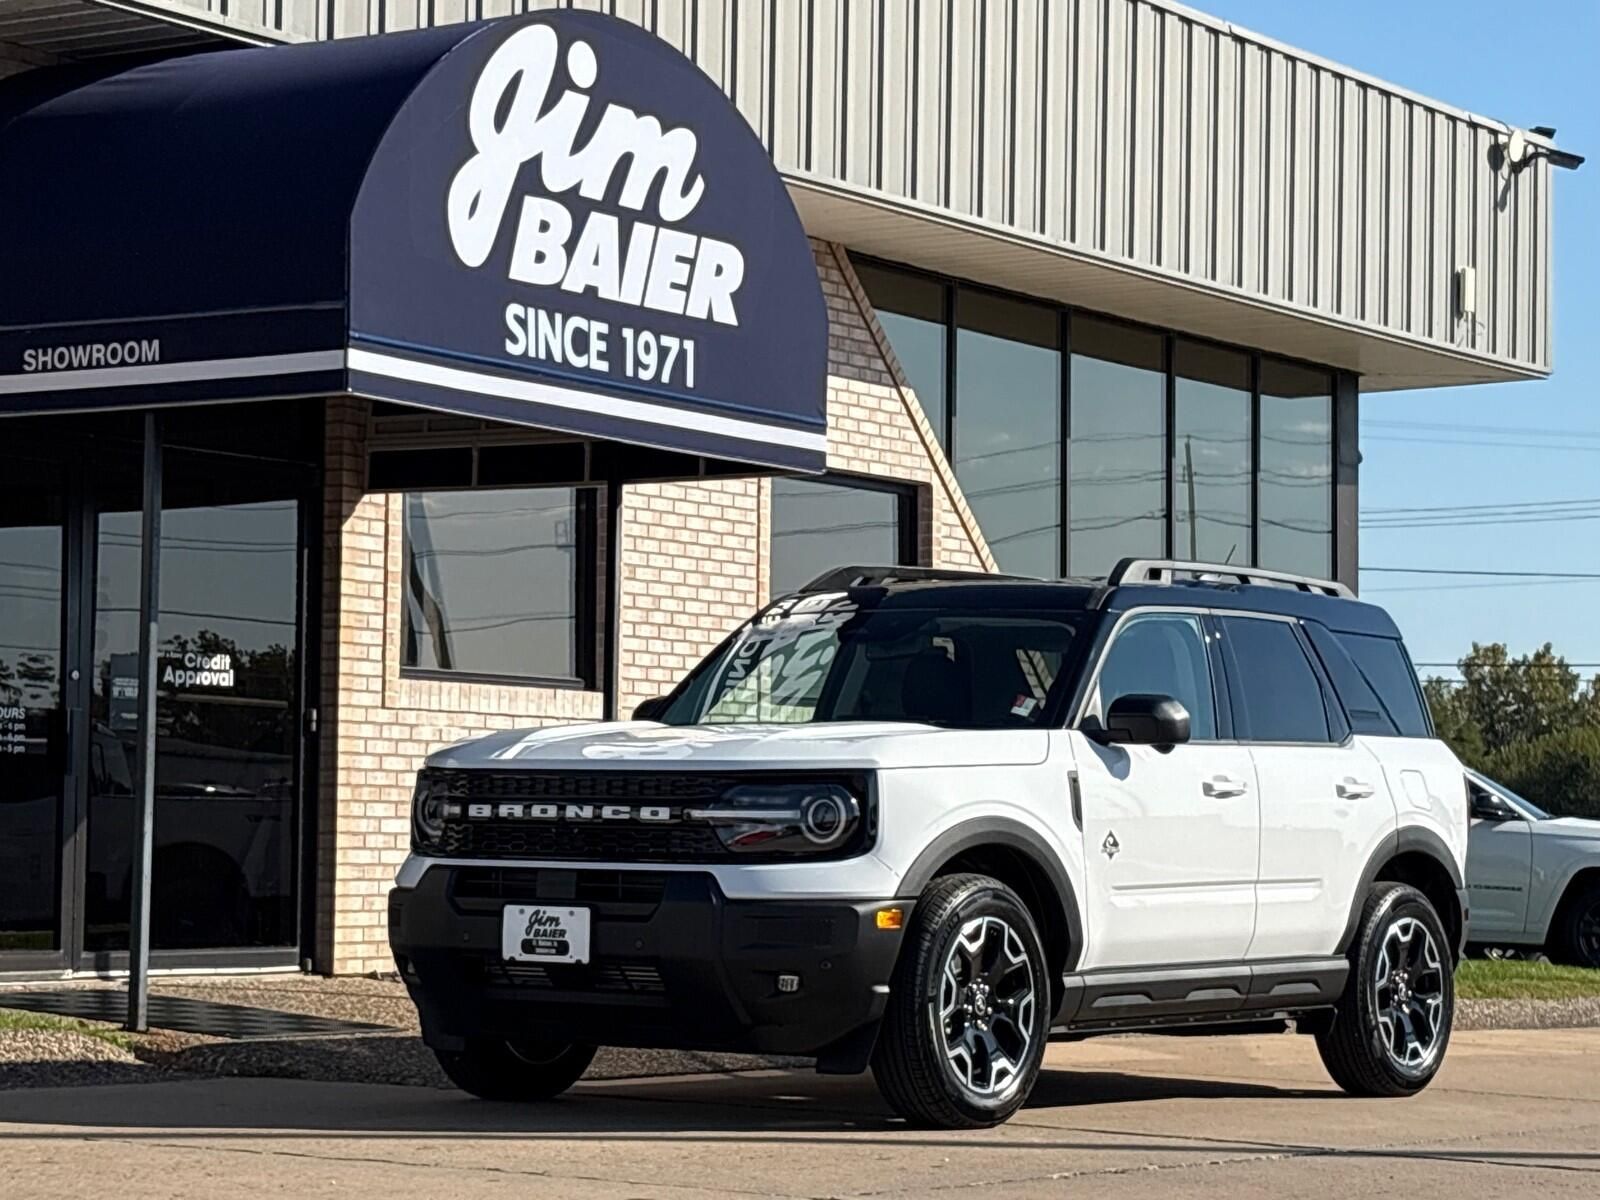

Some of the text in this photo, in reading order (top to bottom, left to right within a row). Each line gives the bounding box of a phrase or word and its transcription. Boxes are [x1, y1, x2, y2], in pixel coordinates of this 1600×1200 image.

[447, 23, 705, 268] Jim
[508, 194, 745, 327] BAIER
[22, 338, 160, 371] SHOWROOM
[504, 302, 696, 389] SINCE 1971
[184, 652, 231, 670] Credit
[162, 664, 234, 688] Approval
[468, 804, 670, 819] BRONCO
[525, 909, 561, 937] Jim
[533, 929, 567, 939] BAIER
